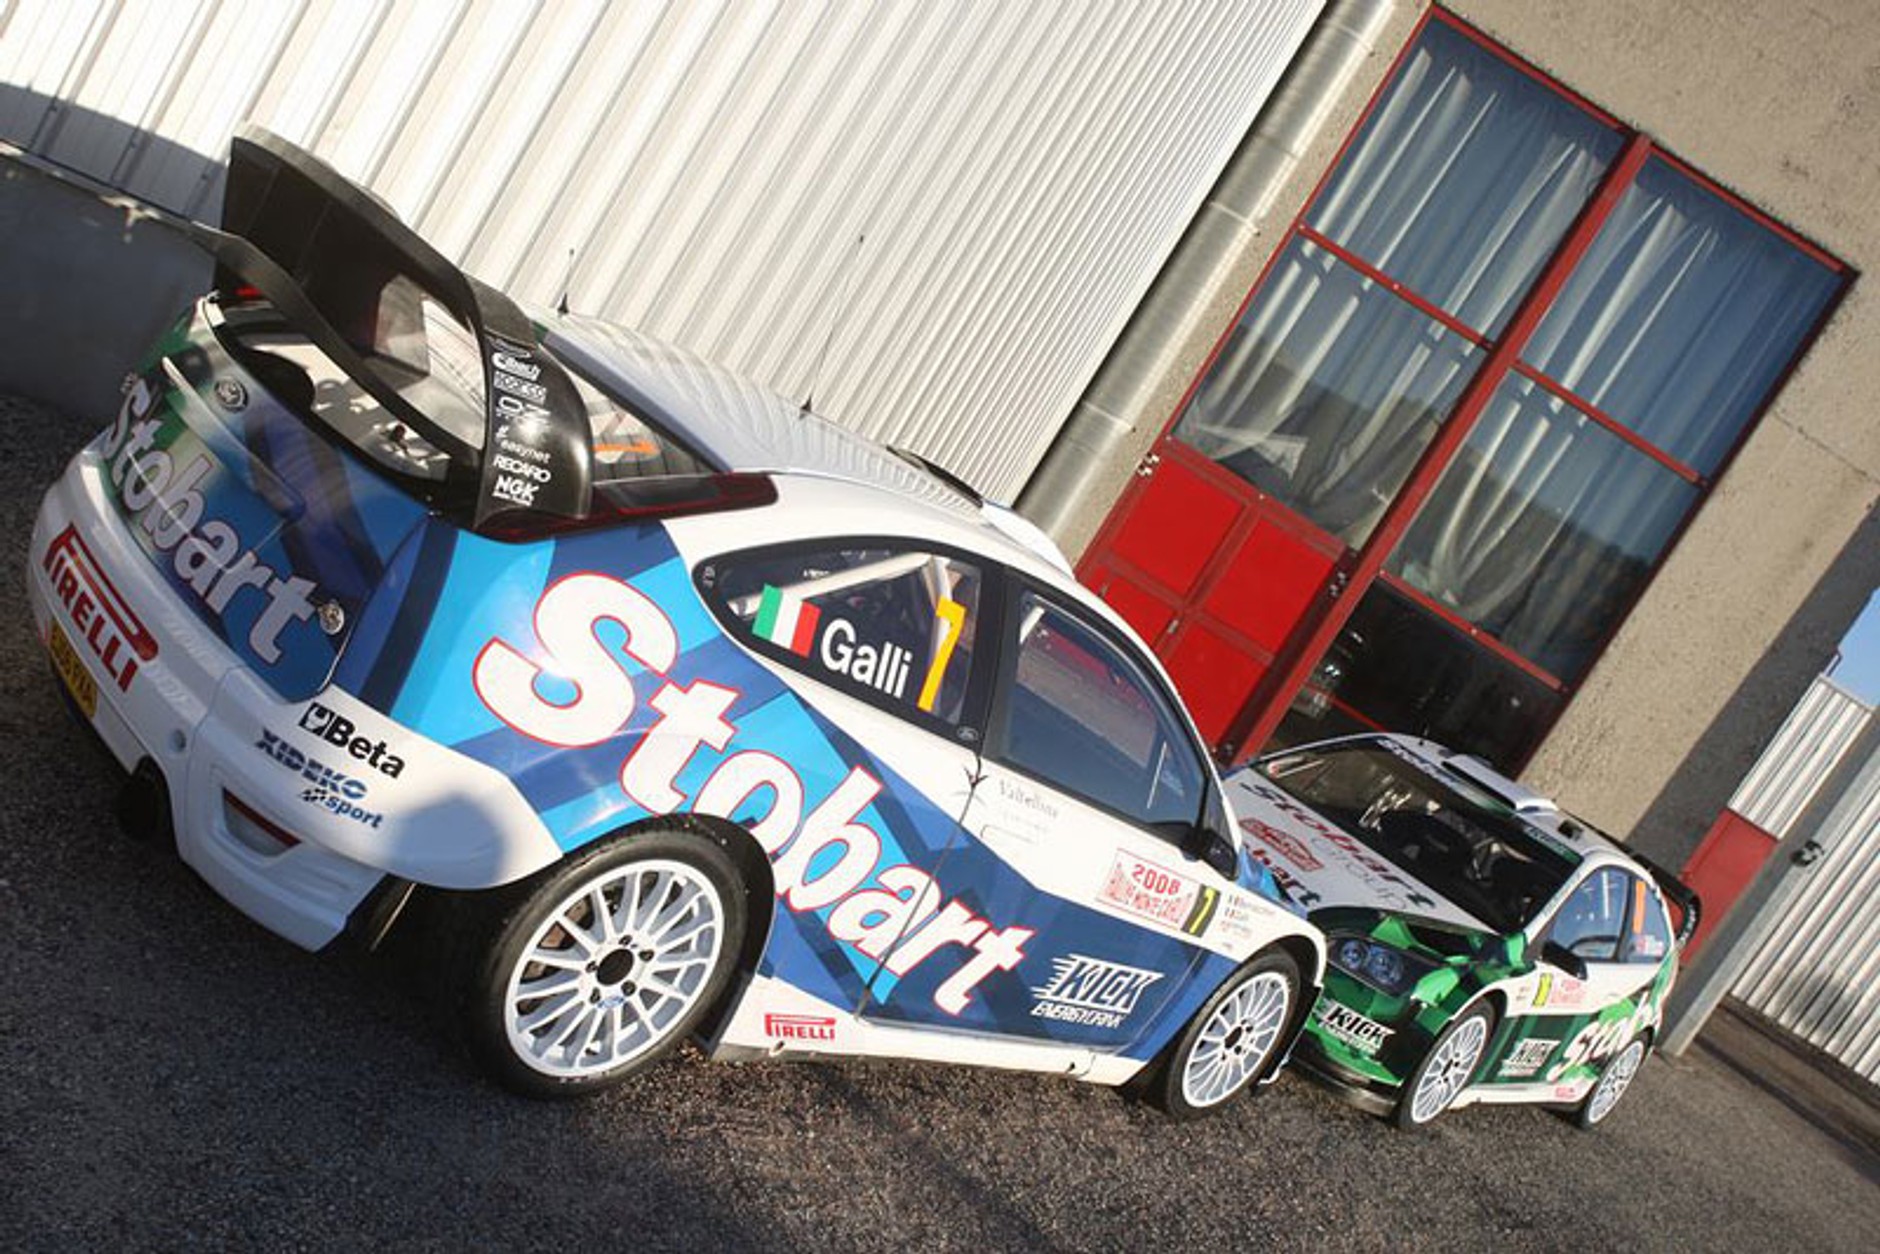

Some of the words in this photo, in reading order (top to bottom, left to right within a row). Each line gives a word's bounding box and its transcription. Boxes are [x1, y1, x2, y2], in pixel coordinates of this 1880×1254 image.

[493, 455, 551, 482] RECARO
[495, 475, 540, 502] NGK
[101, 378, 318, 665] Stobart
[43, 521, 159, 692] PIRELLI
[820, 617, 913, 699] Galli
[917, 596, 976, 712] 7
[255, 727, 368, 799] XIDEKO
[323, 715, 405, 779] Beta
[325, 795, 383, 829] sport
[471, 570, 1038, 1017] Stobart
[1132, 863, 1181, 896] 2008
[1051, 959, 1152, 1009] KICK
[764, 1012, 836, 1040] PIRELLI
